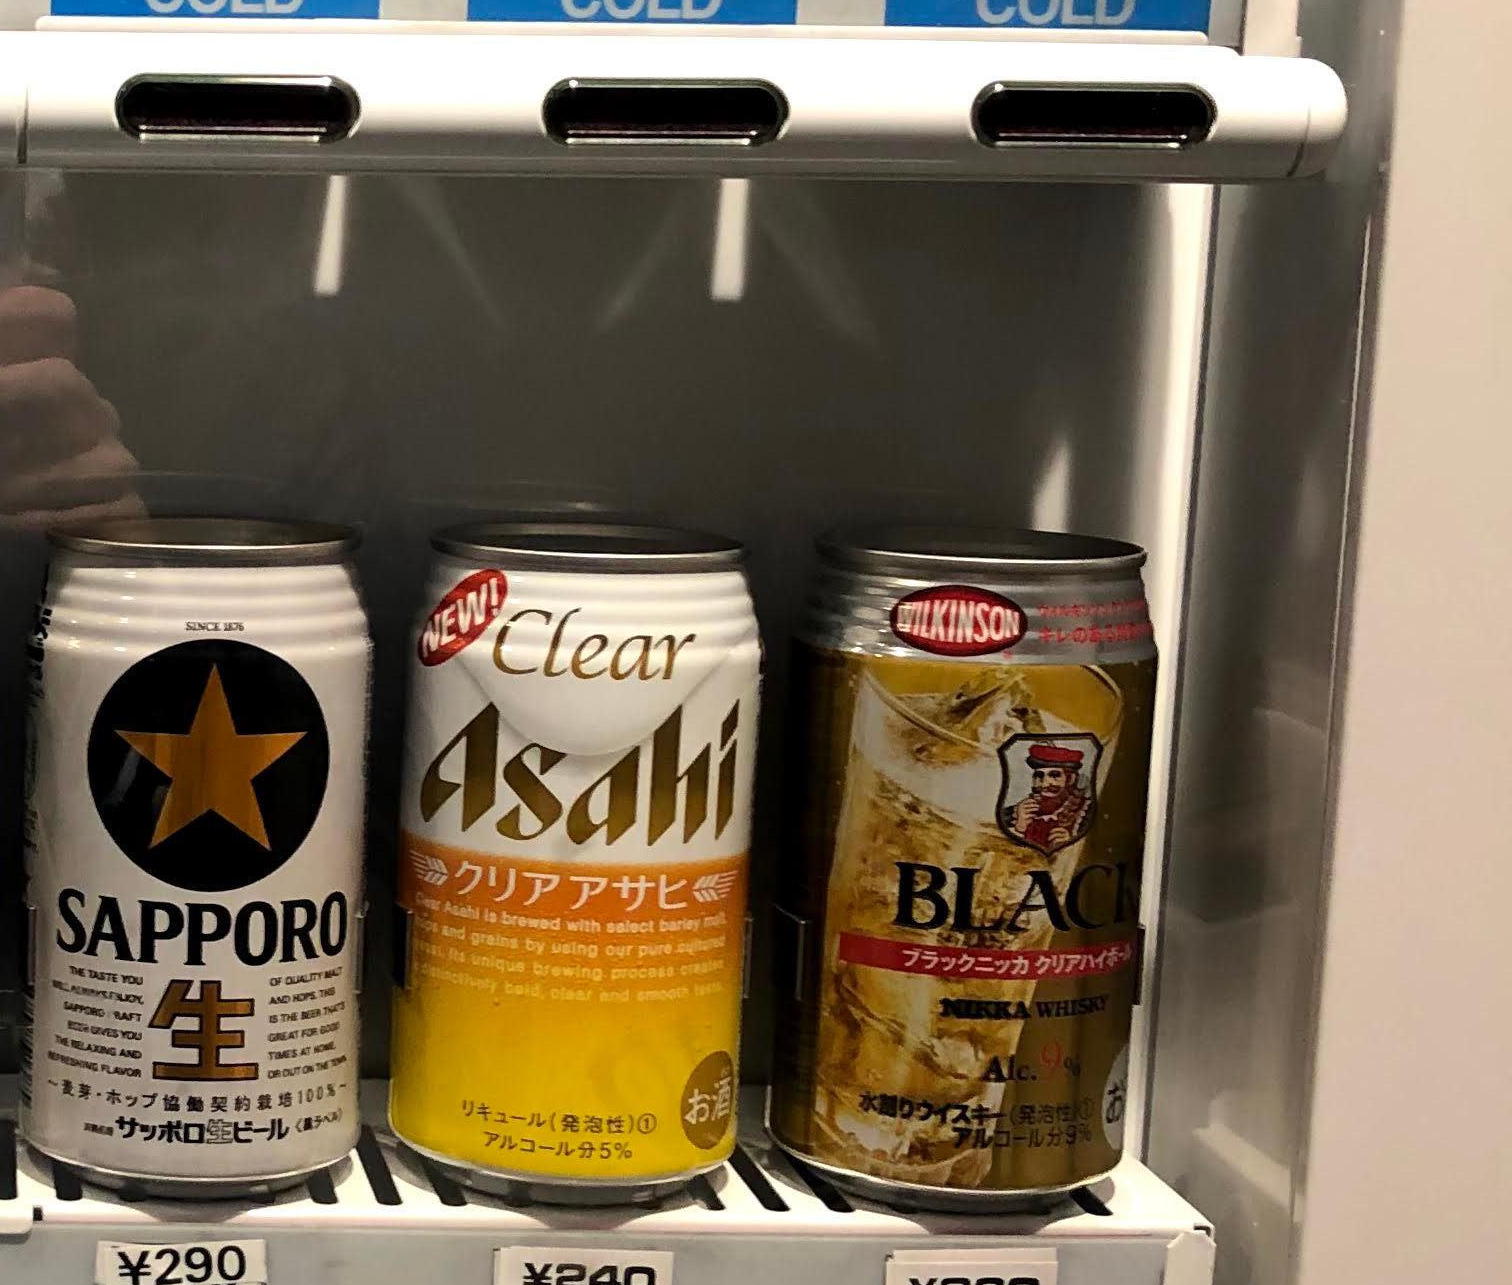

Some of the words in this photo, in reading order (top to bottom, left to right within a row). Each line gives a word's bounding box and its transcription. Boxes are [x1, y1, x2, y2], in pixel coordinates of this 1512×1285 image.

[422, 577, 500, 653] NEW!
[492, 607, 697, 681] Clear
[896, 599, 1021, 644] WILKINSON
[420, 698, 740, 847] Asahi
[56, 888, 348, 966] SAPPORO
[500, 910, 561, 931] brewed
[567, 918, 601, 933] with
[148, 978, 259, 1082] 生
[117, 1247, 247, 1285] ¥290
